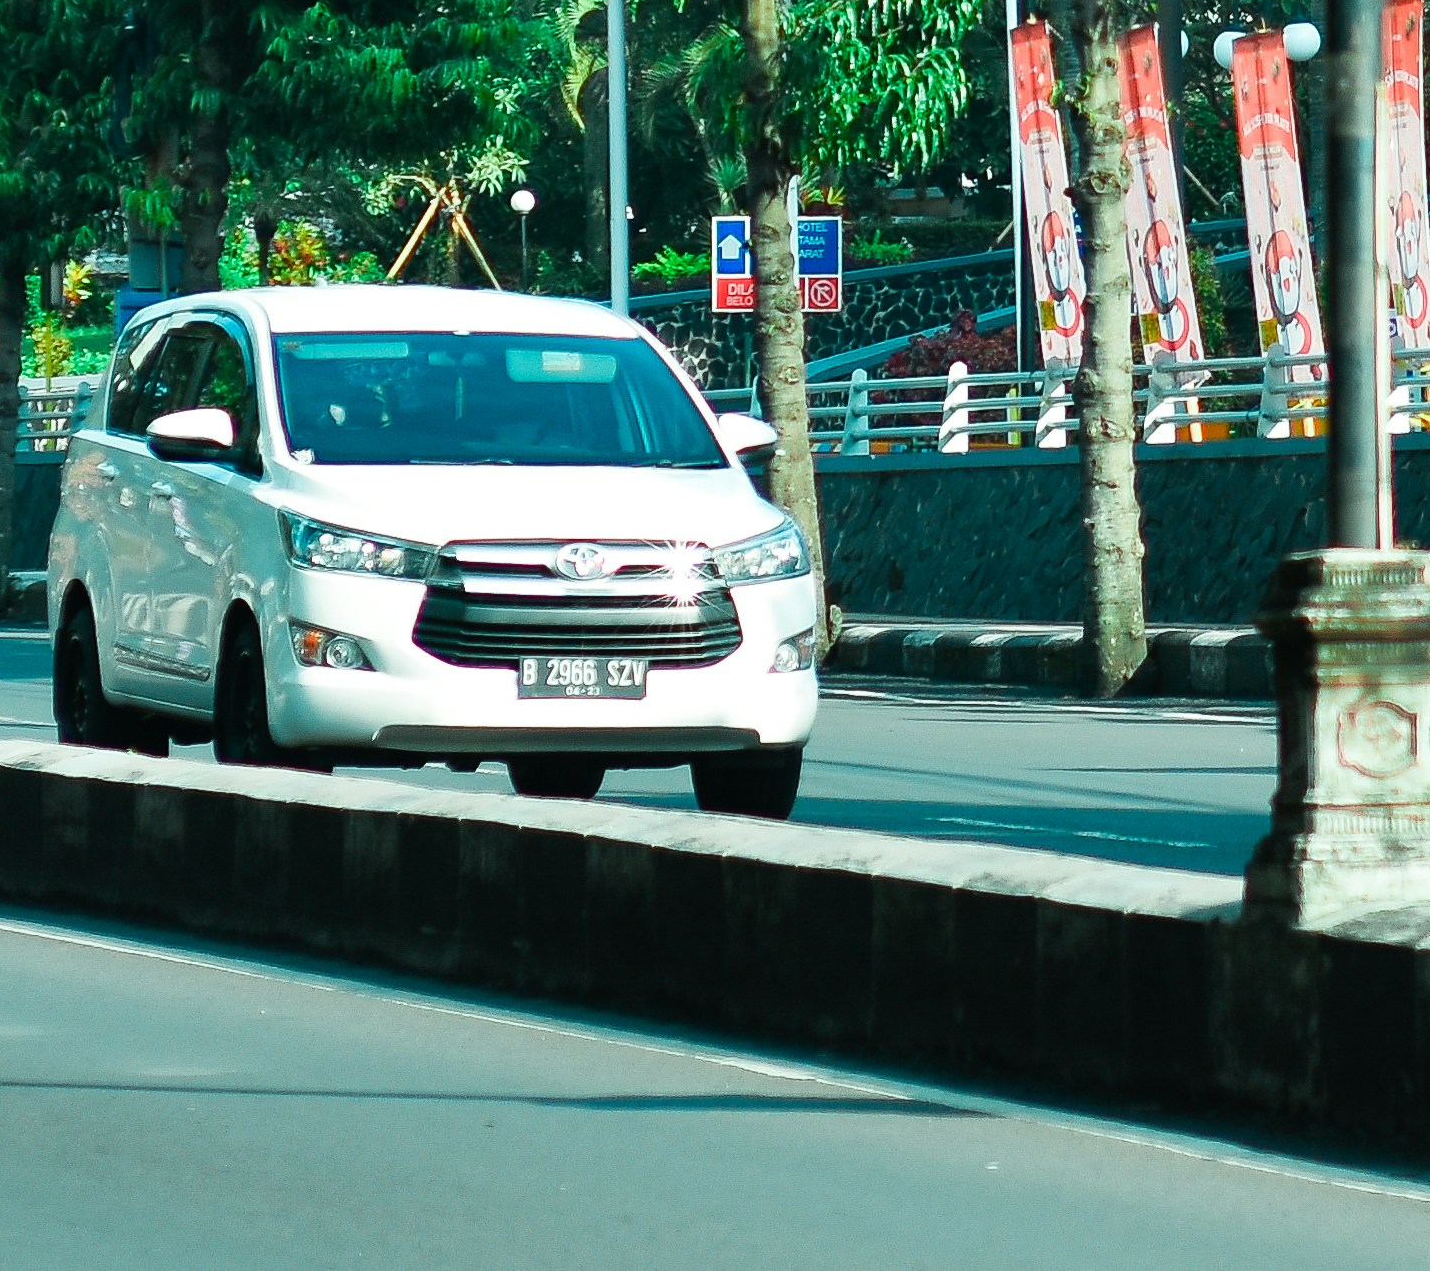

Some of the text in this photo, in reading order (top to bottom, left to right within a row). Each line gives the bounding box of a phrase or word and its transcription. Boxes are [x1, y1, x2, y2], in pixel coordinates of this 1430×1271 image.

[799, 235, 826, 246] TAMA
[799, 249, 825, 259] ARAT
[728, 283, 754, 295] DILA
[726, 296, 754, 306] BELO
[522, 658, 647, 688] B 2966 SZV
